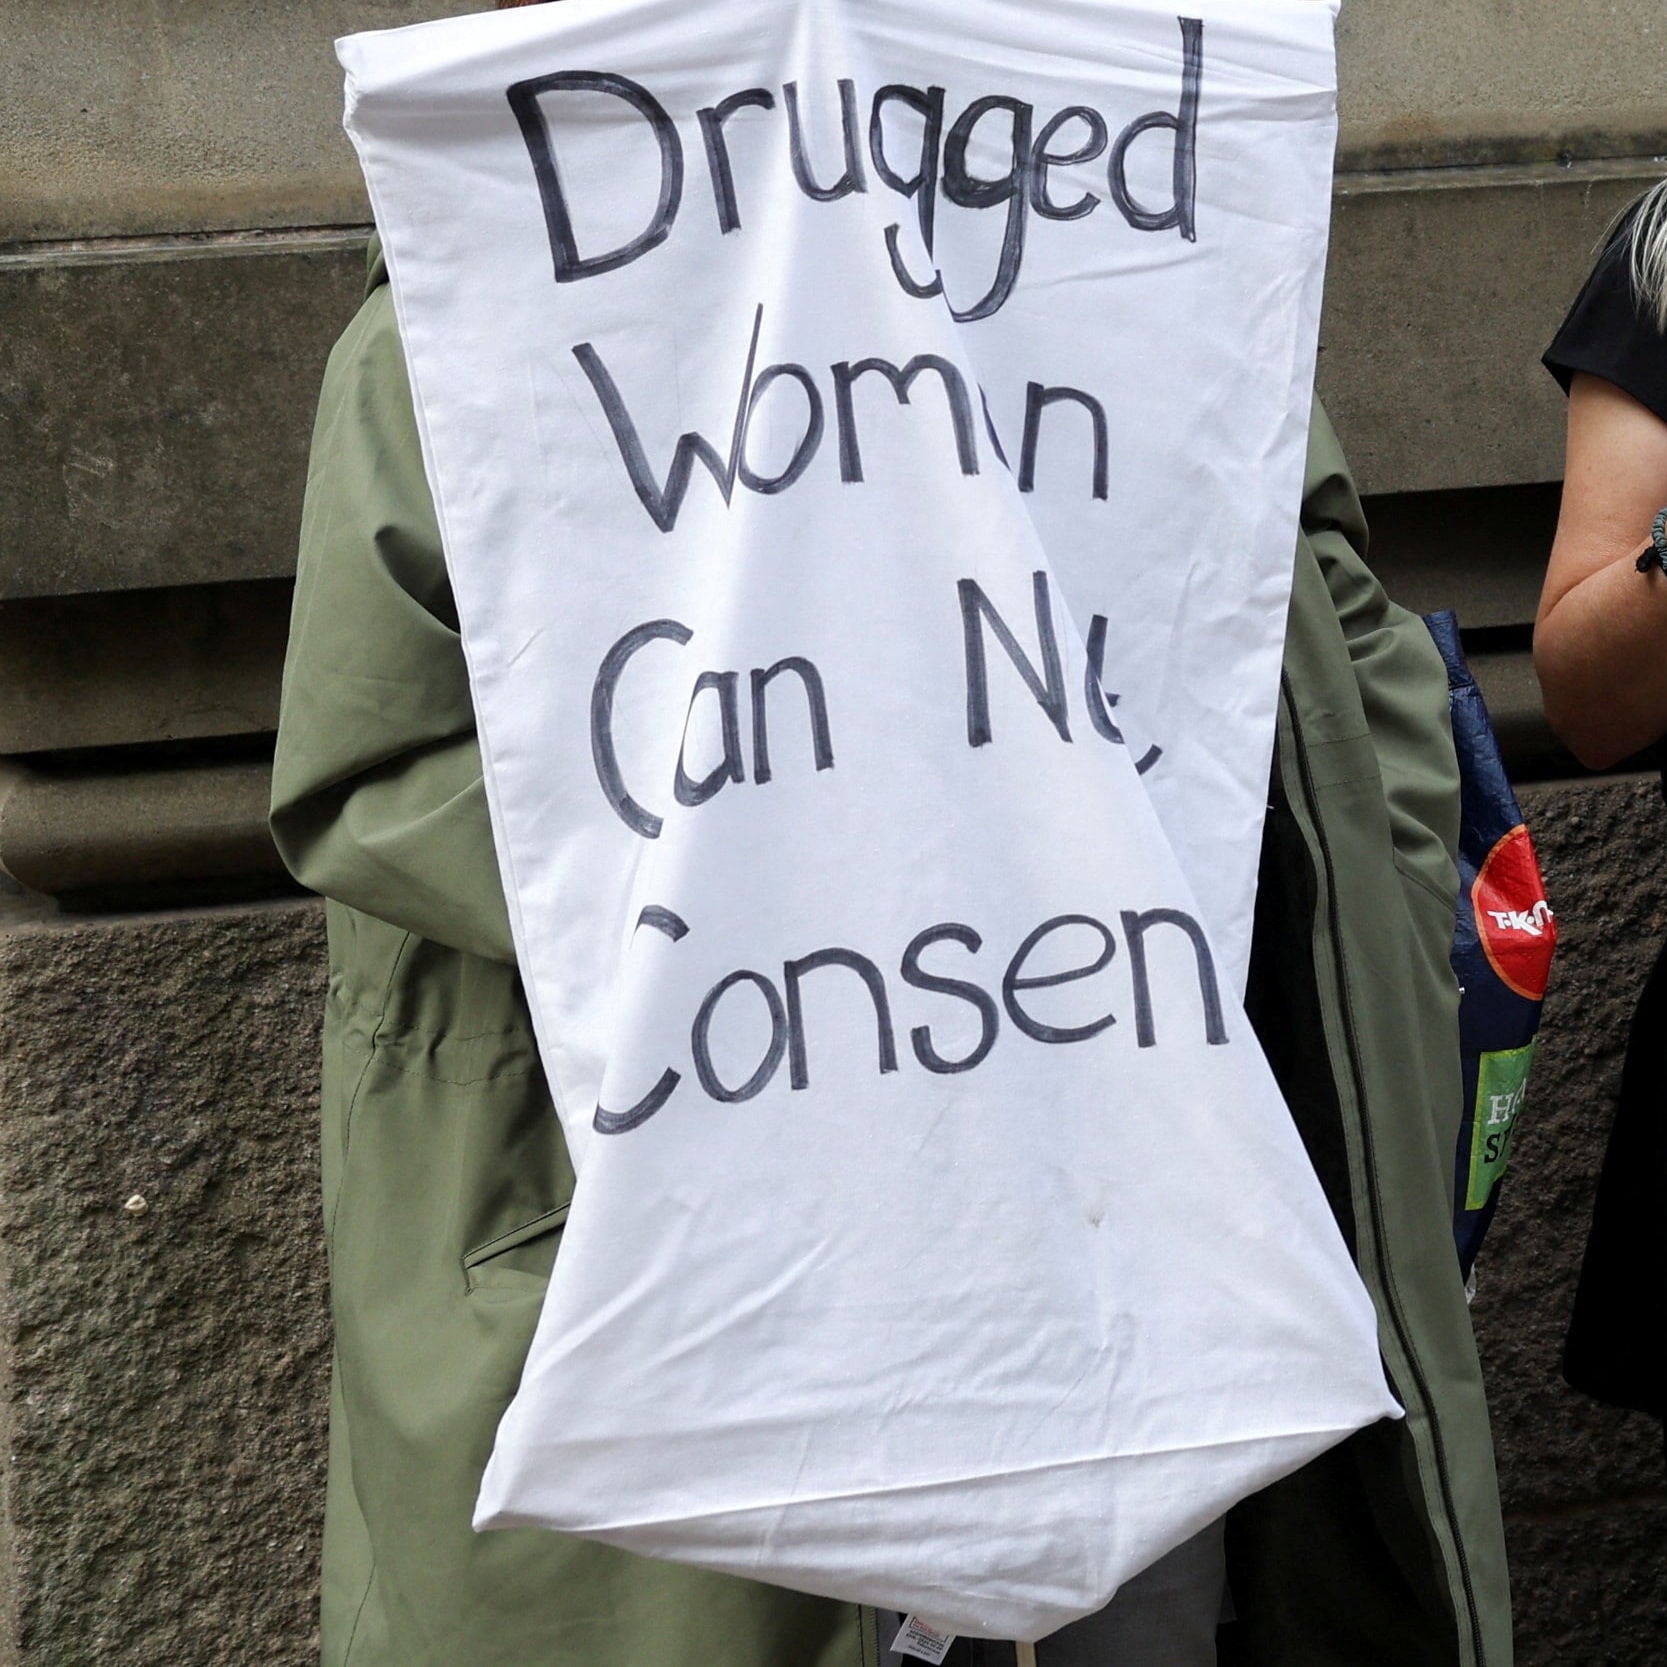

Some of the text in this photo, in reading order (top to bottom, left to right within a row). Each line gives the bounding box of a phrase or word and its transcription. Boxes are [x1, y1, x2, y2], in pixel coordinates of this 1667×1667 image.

[506, 16, 1204, 322] Drugged
[571, 303, 1109, 534] Womn
[590, 618, 835, 840] Can
[592, 905, 1230, 1136] Consen
